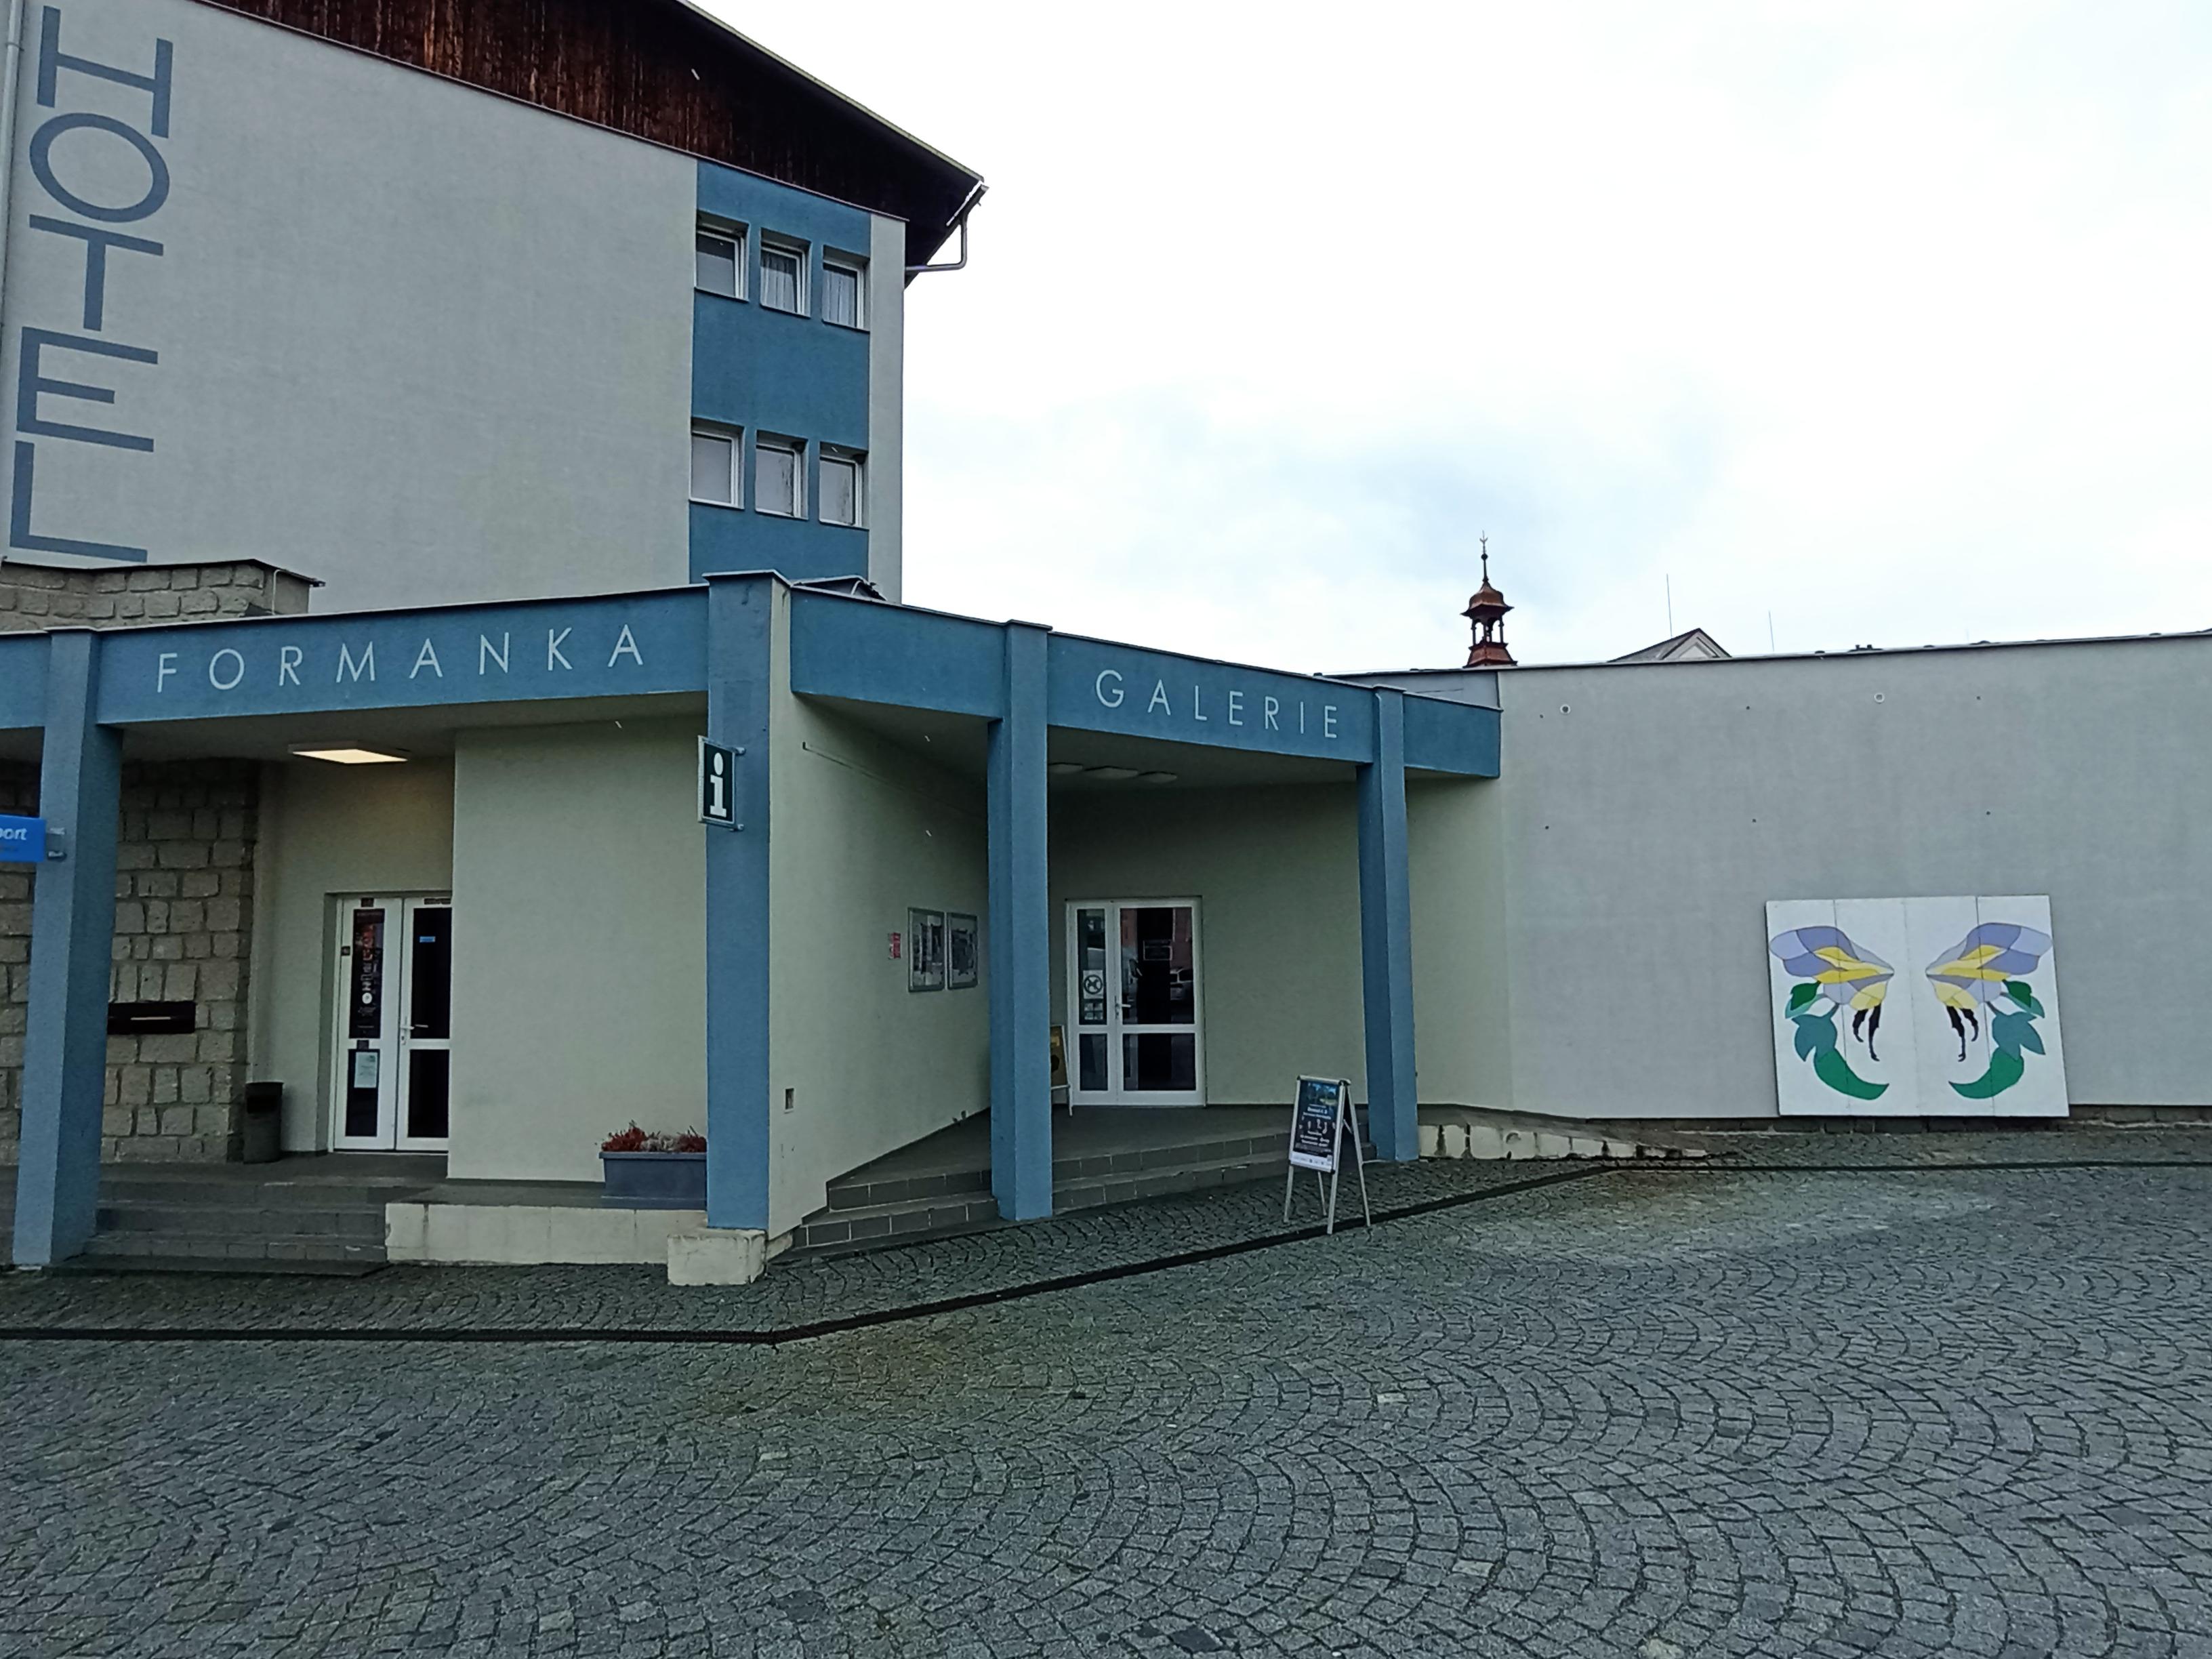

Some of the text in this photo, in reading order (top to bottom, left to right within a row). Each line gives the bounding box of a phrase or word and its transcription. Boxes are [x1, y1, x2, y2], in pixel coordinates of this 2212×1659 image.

[9, 5, 173, 563] HOTEL
[157, 623, 643, 693] FORMANKA
[1095, 670, 1337, 738] GALERIE
